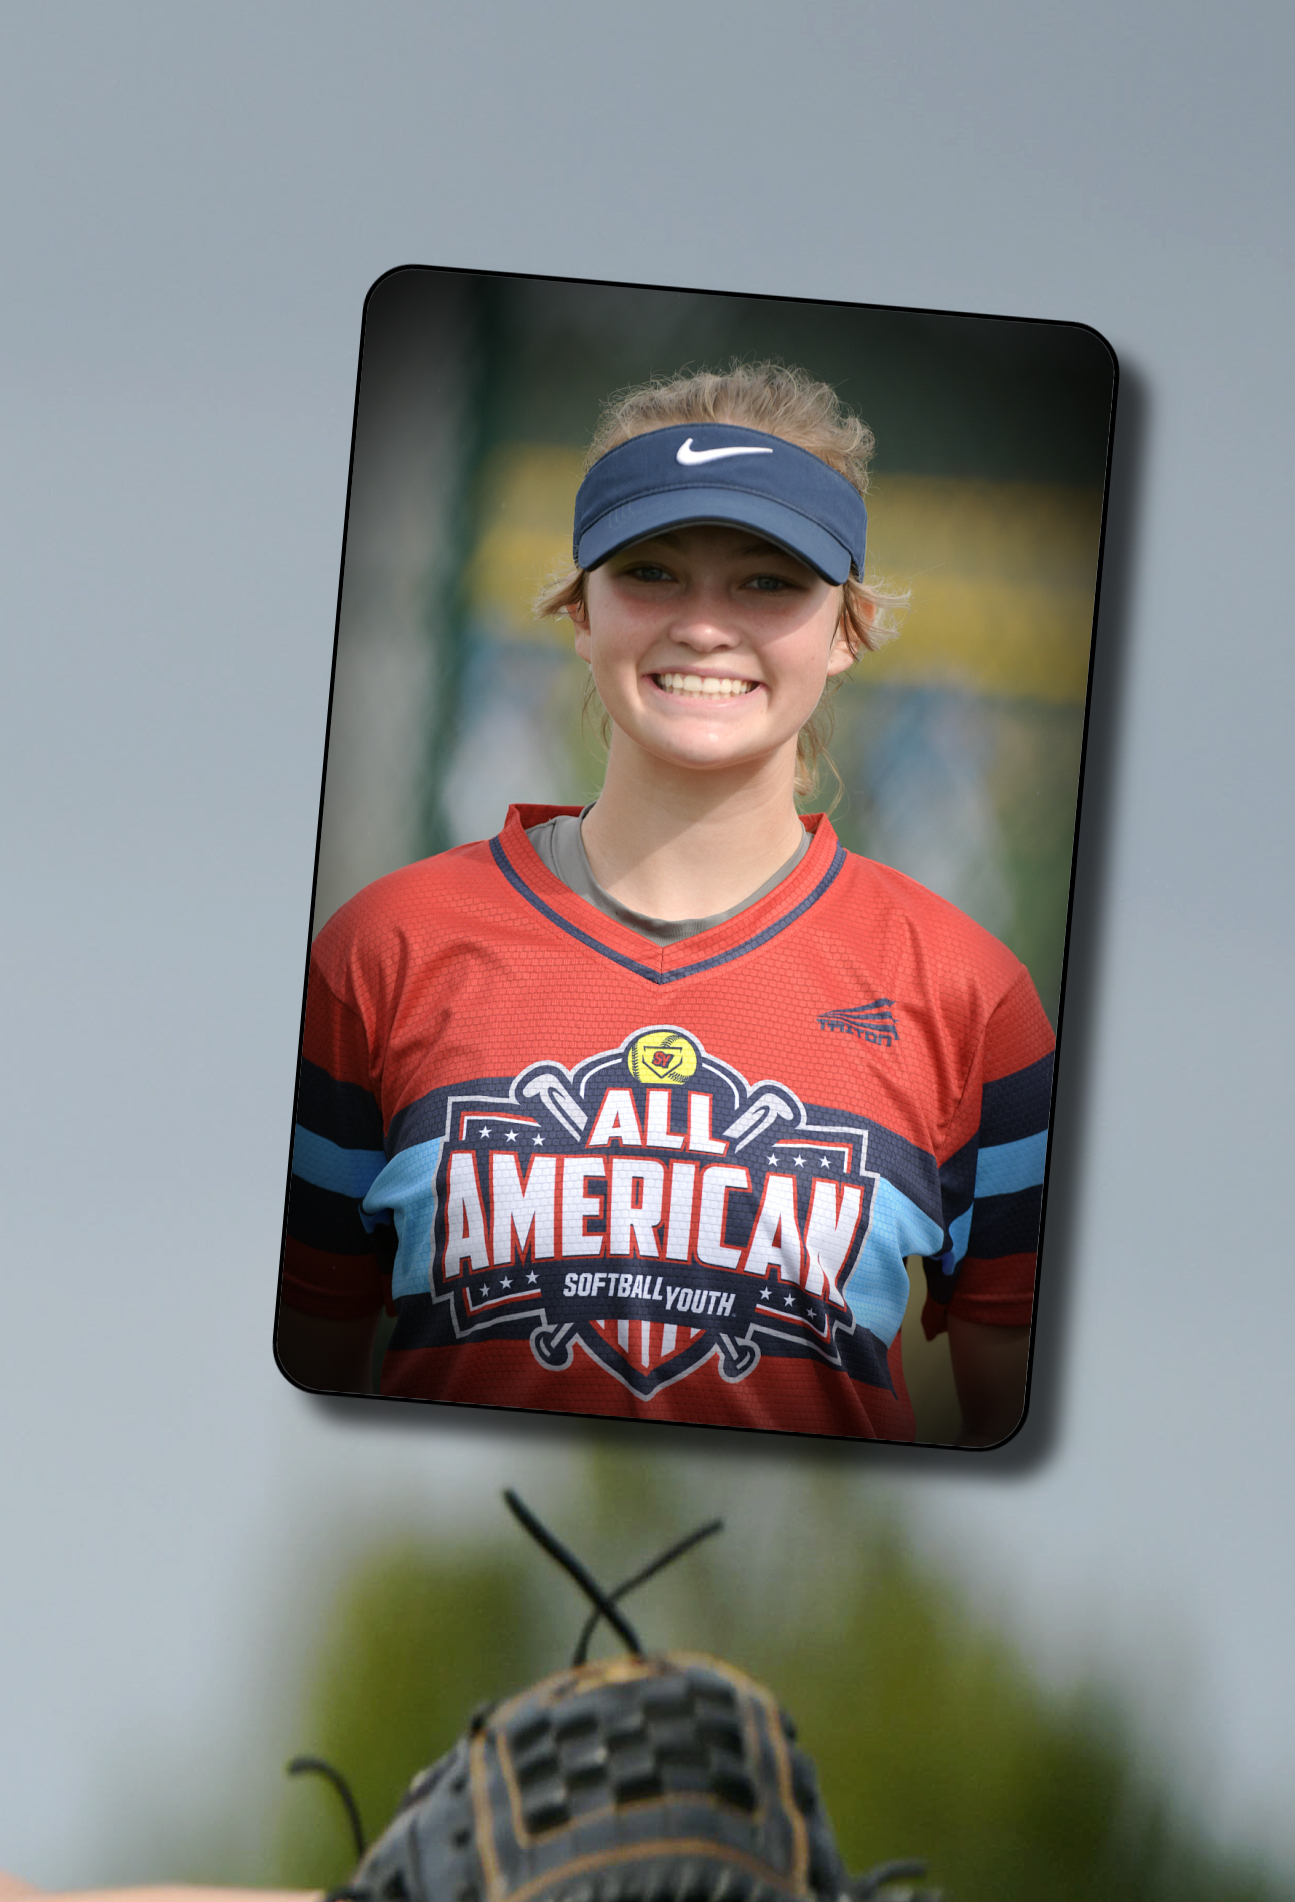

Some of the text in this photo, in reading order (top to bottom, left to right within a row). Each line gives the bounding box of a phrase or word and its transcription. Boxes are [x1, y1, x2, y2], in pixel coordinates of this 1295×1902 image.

[652, 1051, 674, 1068] SY
[586, 1087, 729, 1156] ALL
[443, 1150, 864, 1307] AMERICAN
[563, 1273, 736, 1317] SOFTBALL YOUTH
